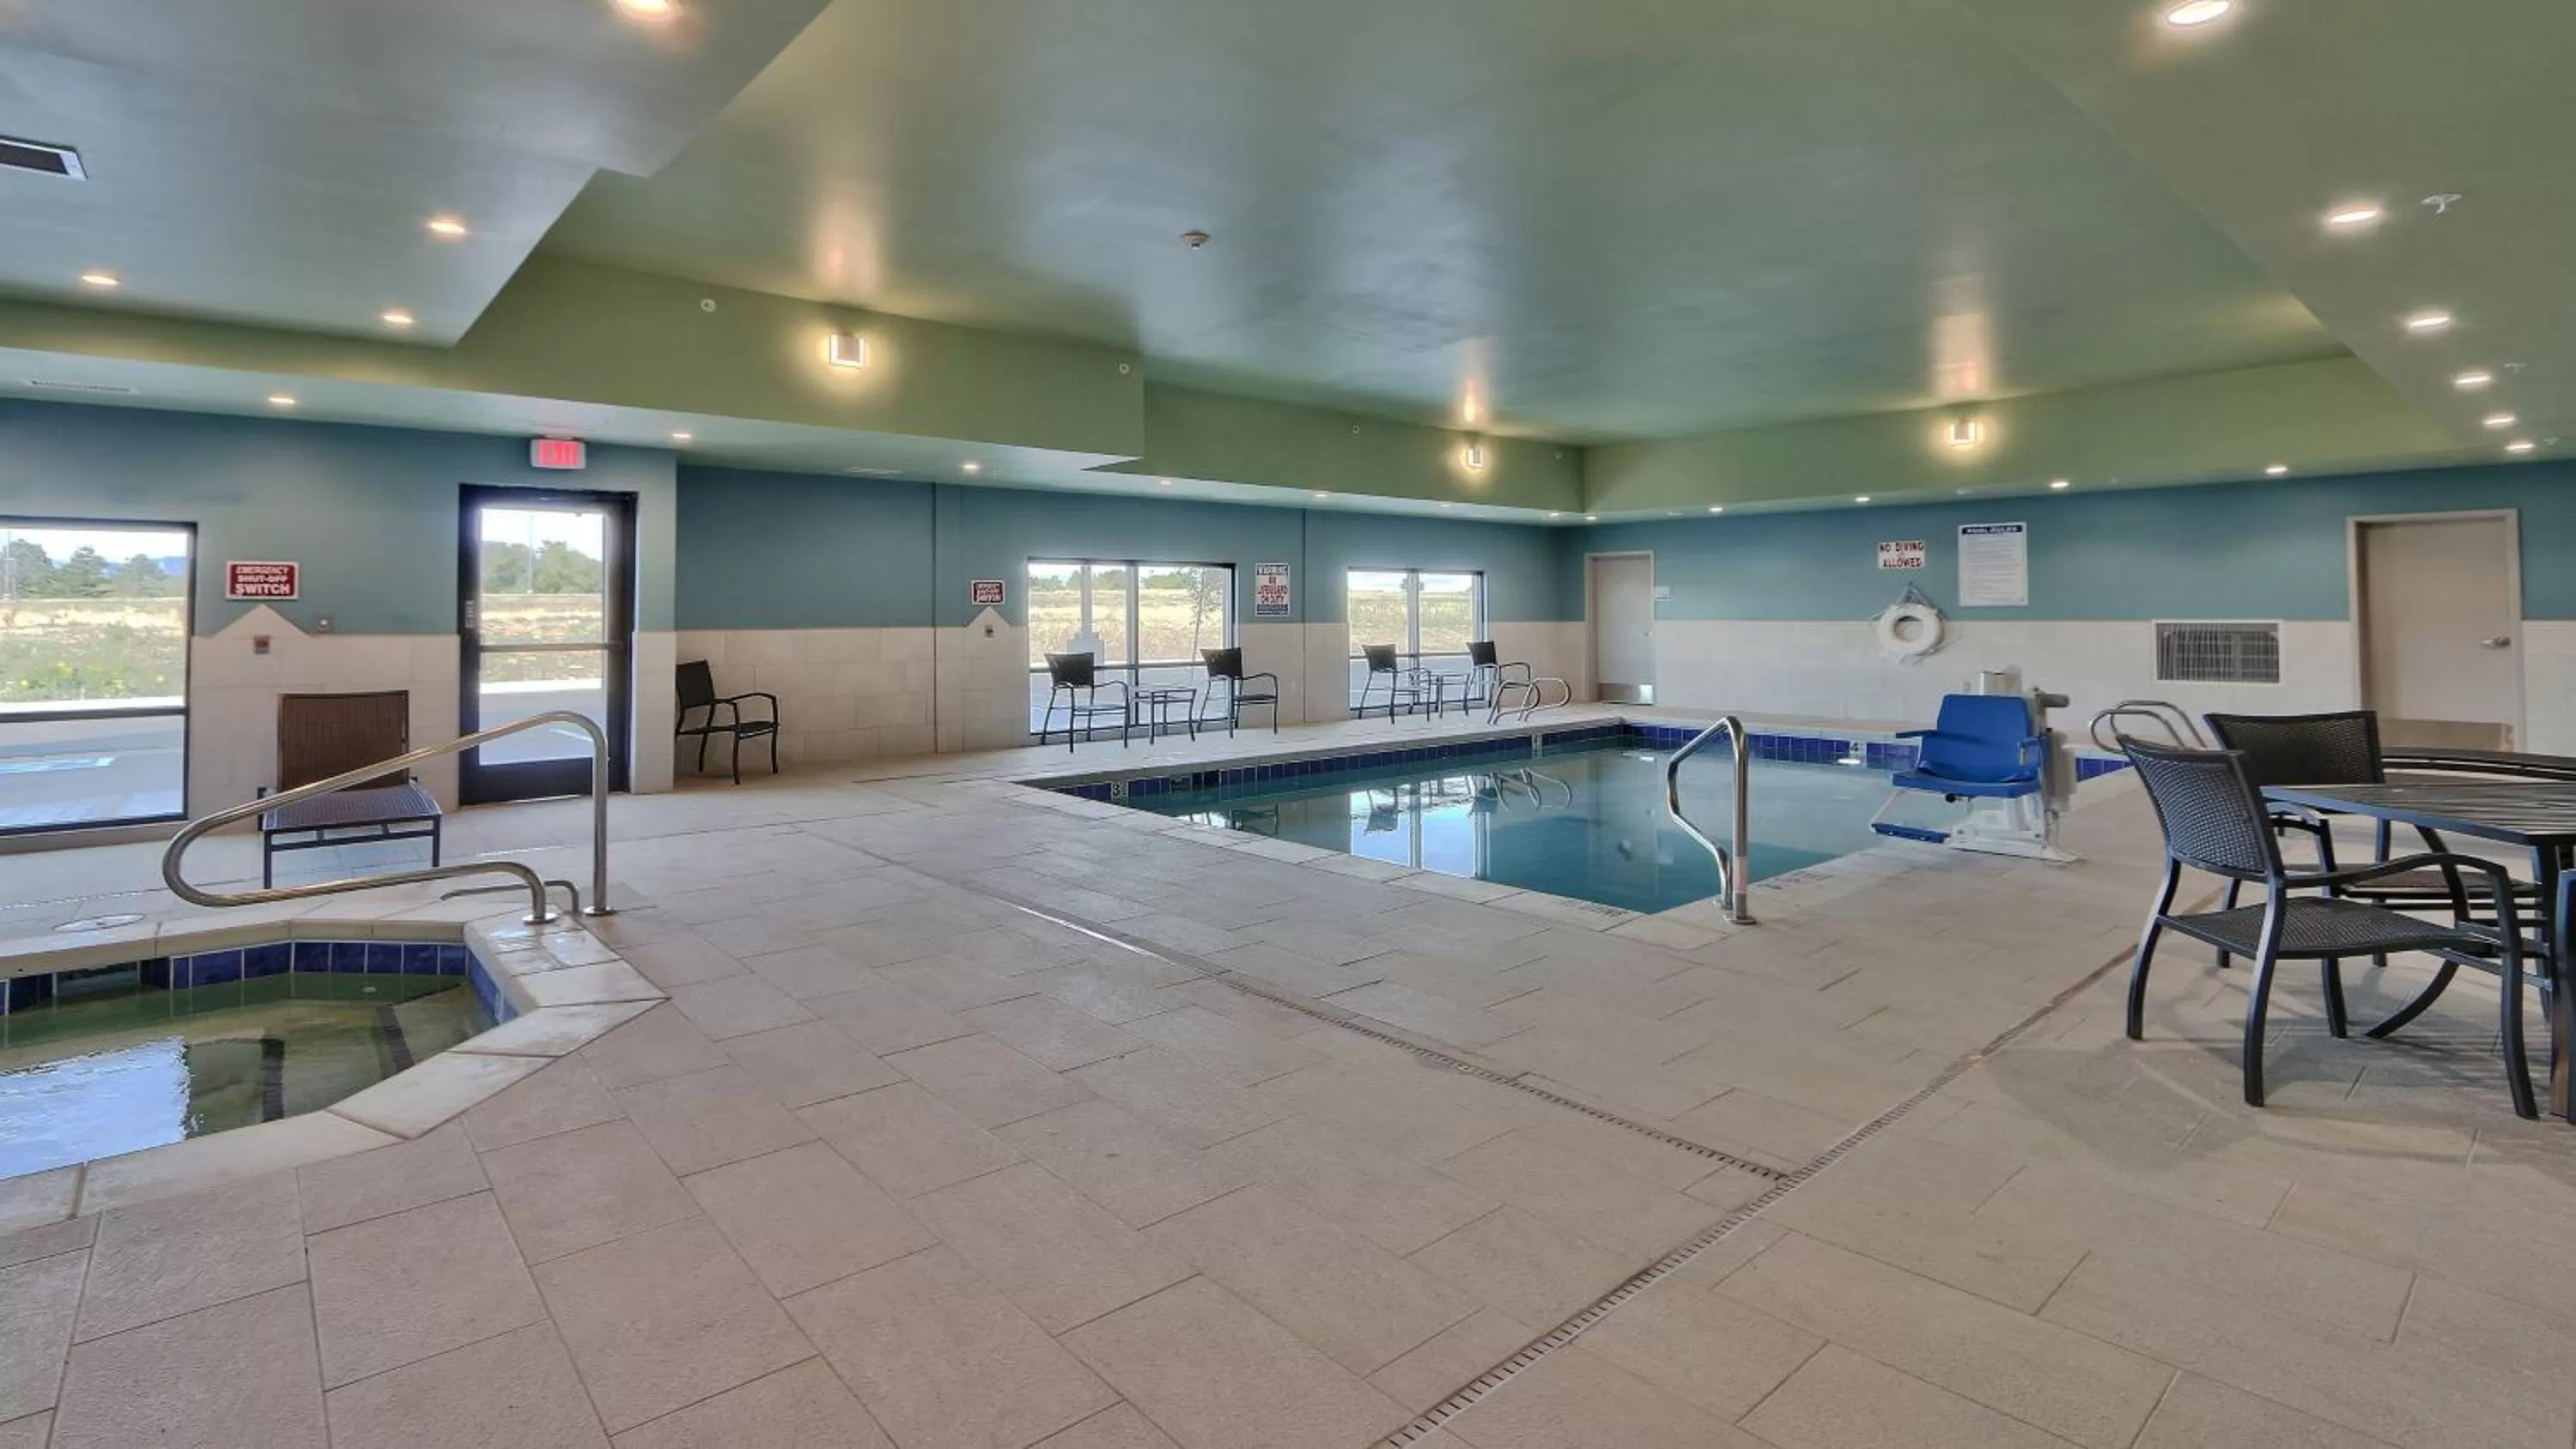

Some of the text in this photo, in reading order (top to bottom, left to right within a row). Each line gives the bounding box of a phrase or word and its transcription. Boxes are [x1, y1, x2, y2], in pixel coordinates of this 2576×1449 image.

[1880, 542, 1924, 552] NO DIVING
[1883, 557, 1923, 567] ALLOWED
[235, 583, 290, 595] SWITCH
[1850, 741, 1860, 753] 4
[1112, 782, 1121, 797] 3
